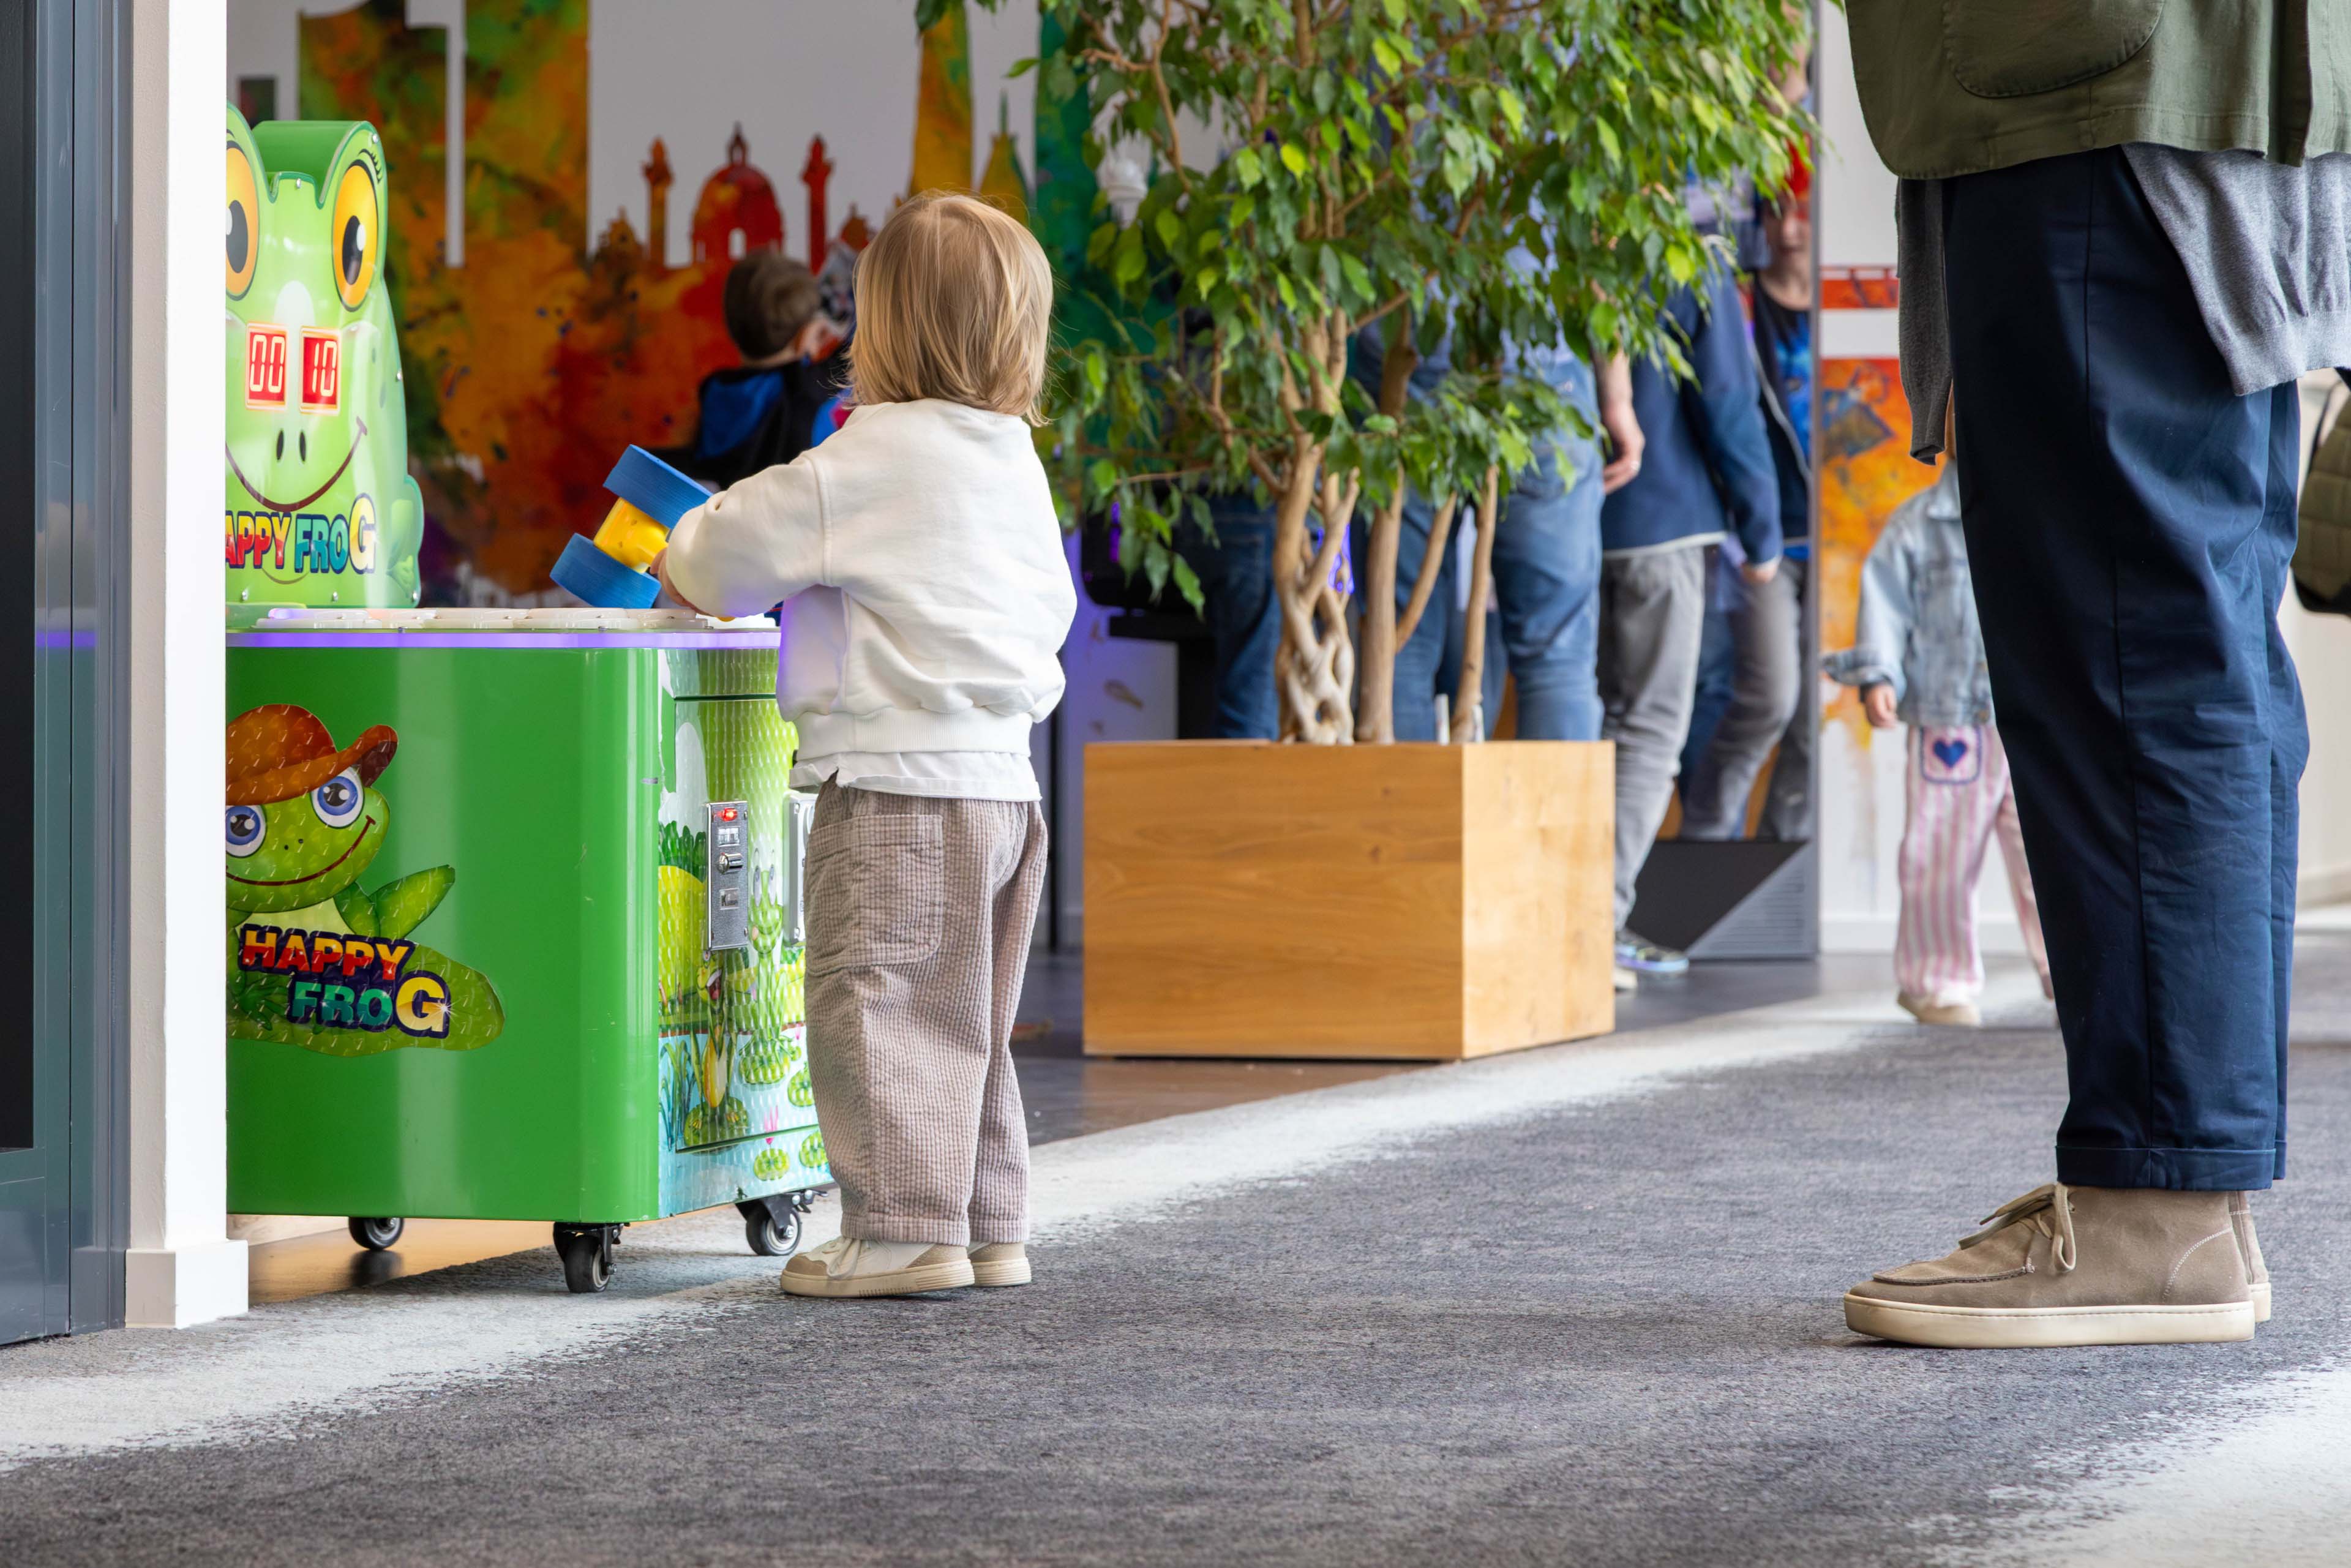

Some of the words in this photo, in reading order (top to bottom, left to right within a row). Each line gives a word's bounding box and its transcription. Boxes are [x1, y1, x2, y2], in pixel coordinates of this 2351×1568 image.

[250, 334, 285, 392] 00
[312, 340, 337, 397] 10
[225, 510, 291, 569] APPY
[294, 493, 376, 574] FROG
[239, 924, 415, 981] HAPPY
[288, 972, 450, 1038] FROG
